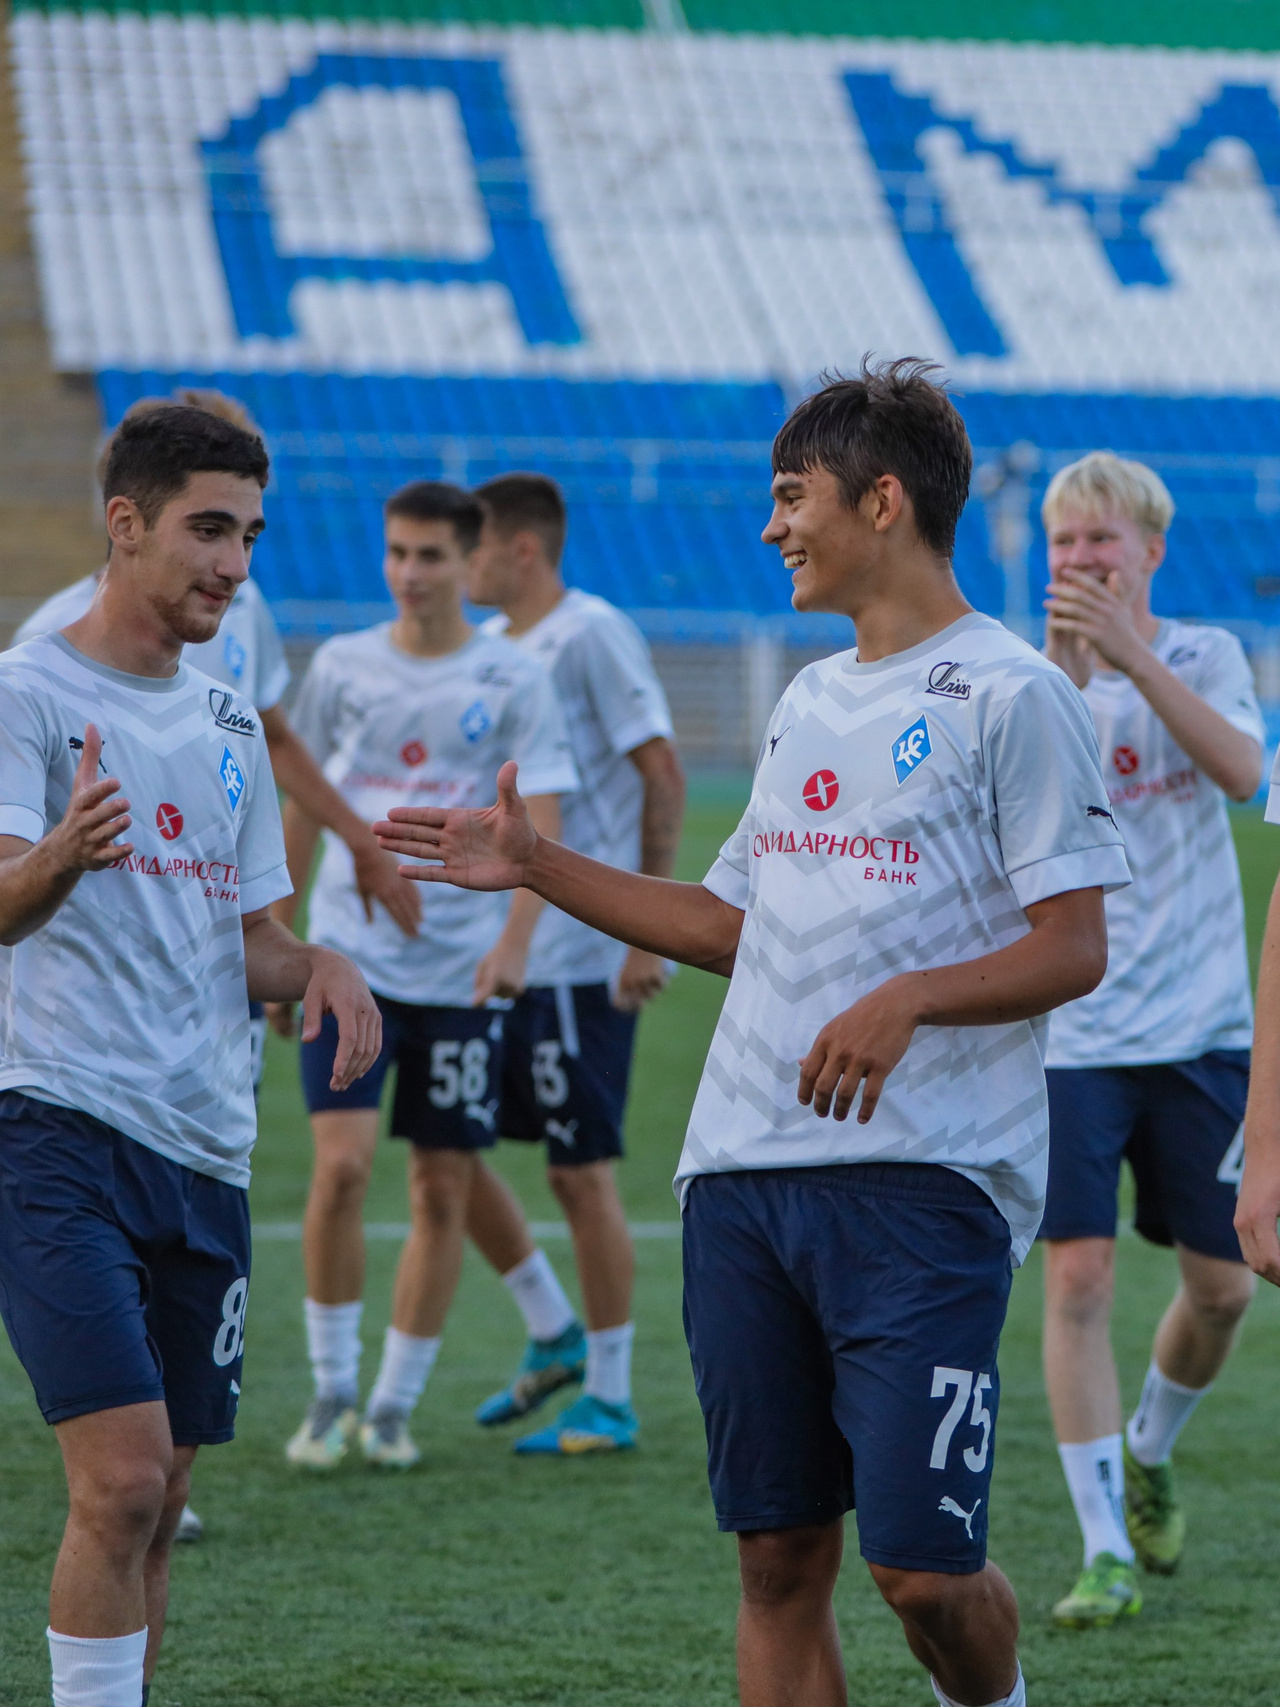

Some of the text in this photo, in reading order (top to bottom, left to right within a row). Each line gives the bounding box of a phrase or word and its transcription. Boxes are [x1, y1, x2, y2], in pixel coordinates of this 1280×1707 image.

[864, 867, 918, 886] БАНК
[428, 1038, 490, 1109] 58
[213, 1276, 249, 1367] 8
[929, 1366, 992, 1473] 75
